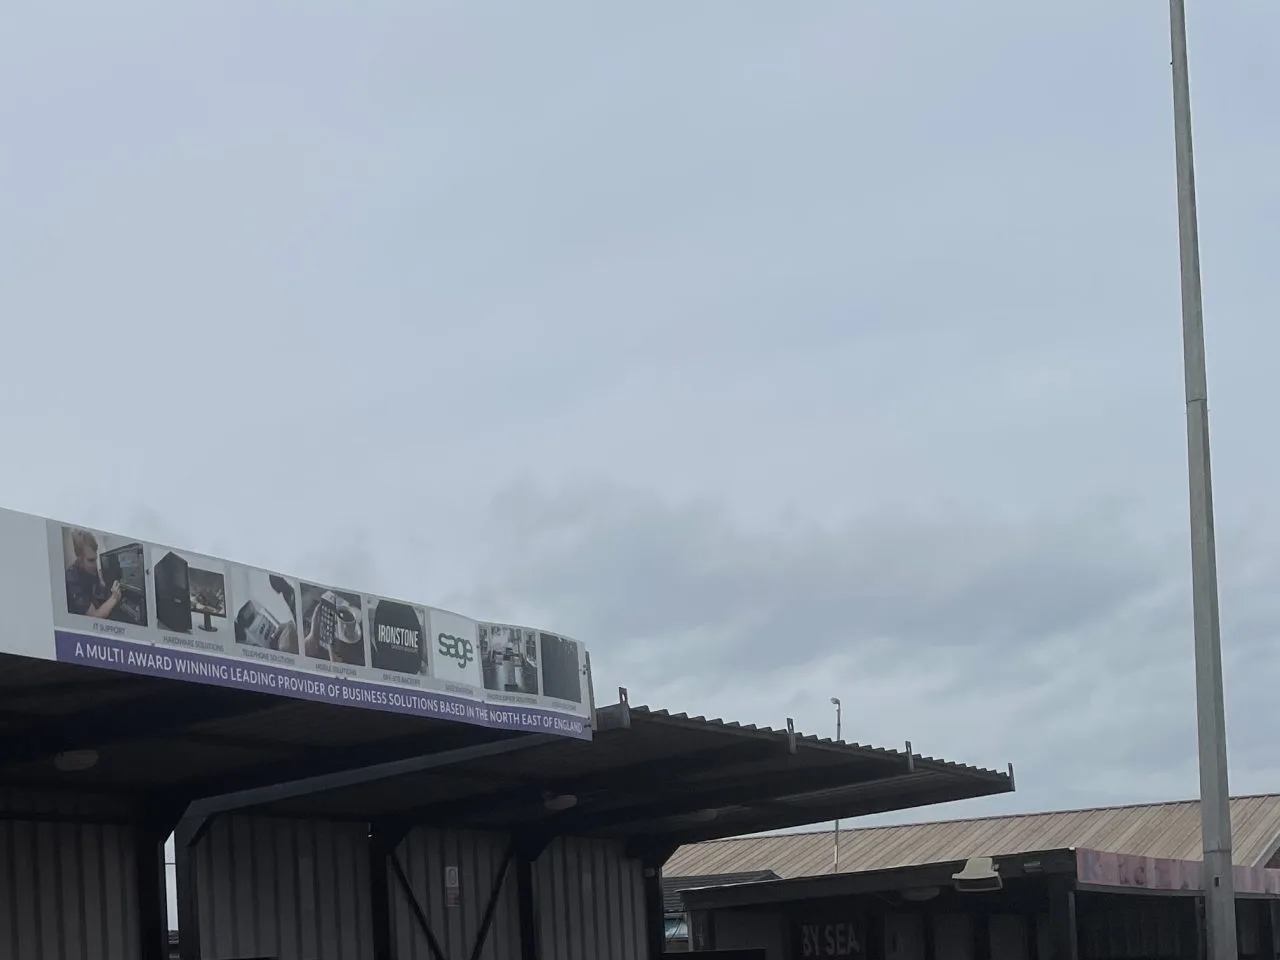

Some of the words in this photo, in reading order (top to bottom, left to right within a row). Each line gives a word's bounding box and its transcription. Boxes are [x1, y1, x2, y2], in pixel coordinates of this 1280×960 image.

[379, 624, 419, 648] IRONSTONE
[438, 633, 474, 669] sage
[75, 642, 84, 657] A
[86, 643, 124, 664] MULTI
[127, 651, 172, 671] AWARD
[175, 659, 228, 679] WINNING
[230, 667, 276, 687] LEADING
[278, 675, 325, 695] PROVIDER
[328, 685, 340, 698] OF
[343, 686, 386, 705] BUSINESS
[389, 693, 438, 713] SOLUTIONS
[440, 701, 465, 716] BASED
[467, 705, 475, 717] IN
[475, 707, 489, 721] THE
[489, 711, 520, 725] NORTH
[522, 713, 541, 727] EAST
[543, 716, 553, 728] OF
[554, 717, 583, 733] ENGLAND
[825, 922, 861, 956] SEA
